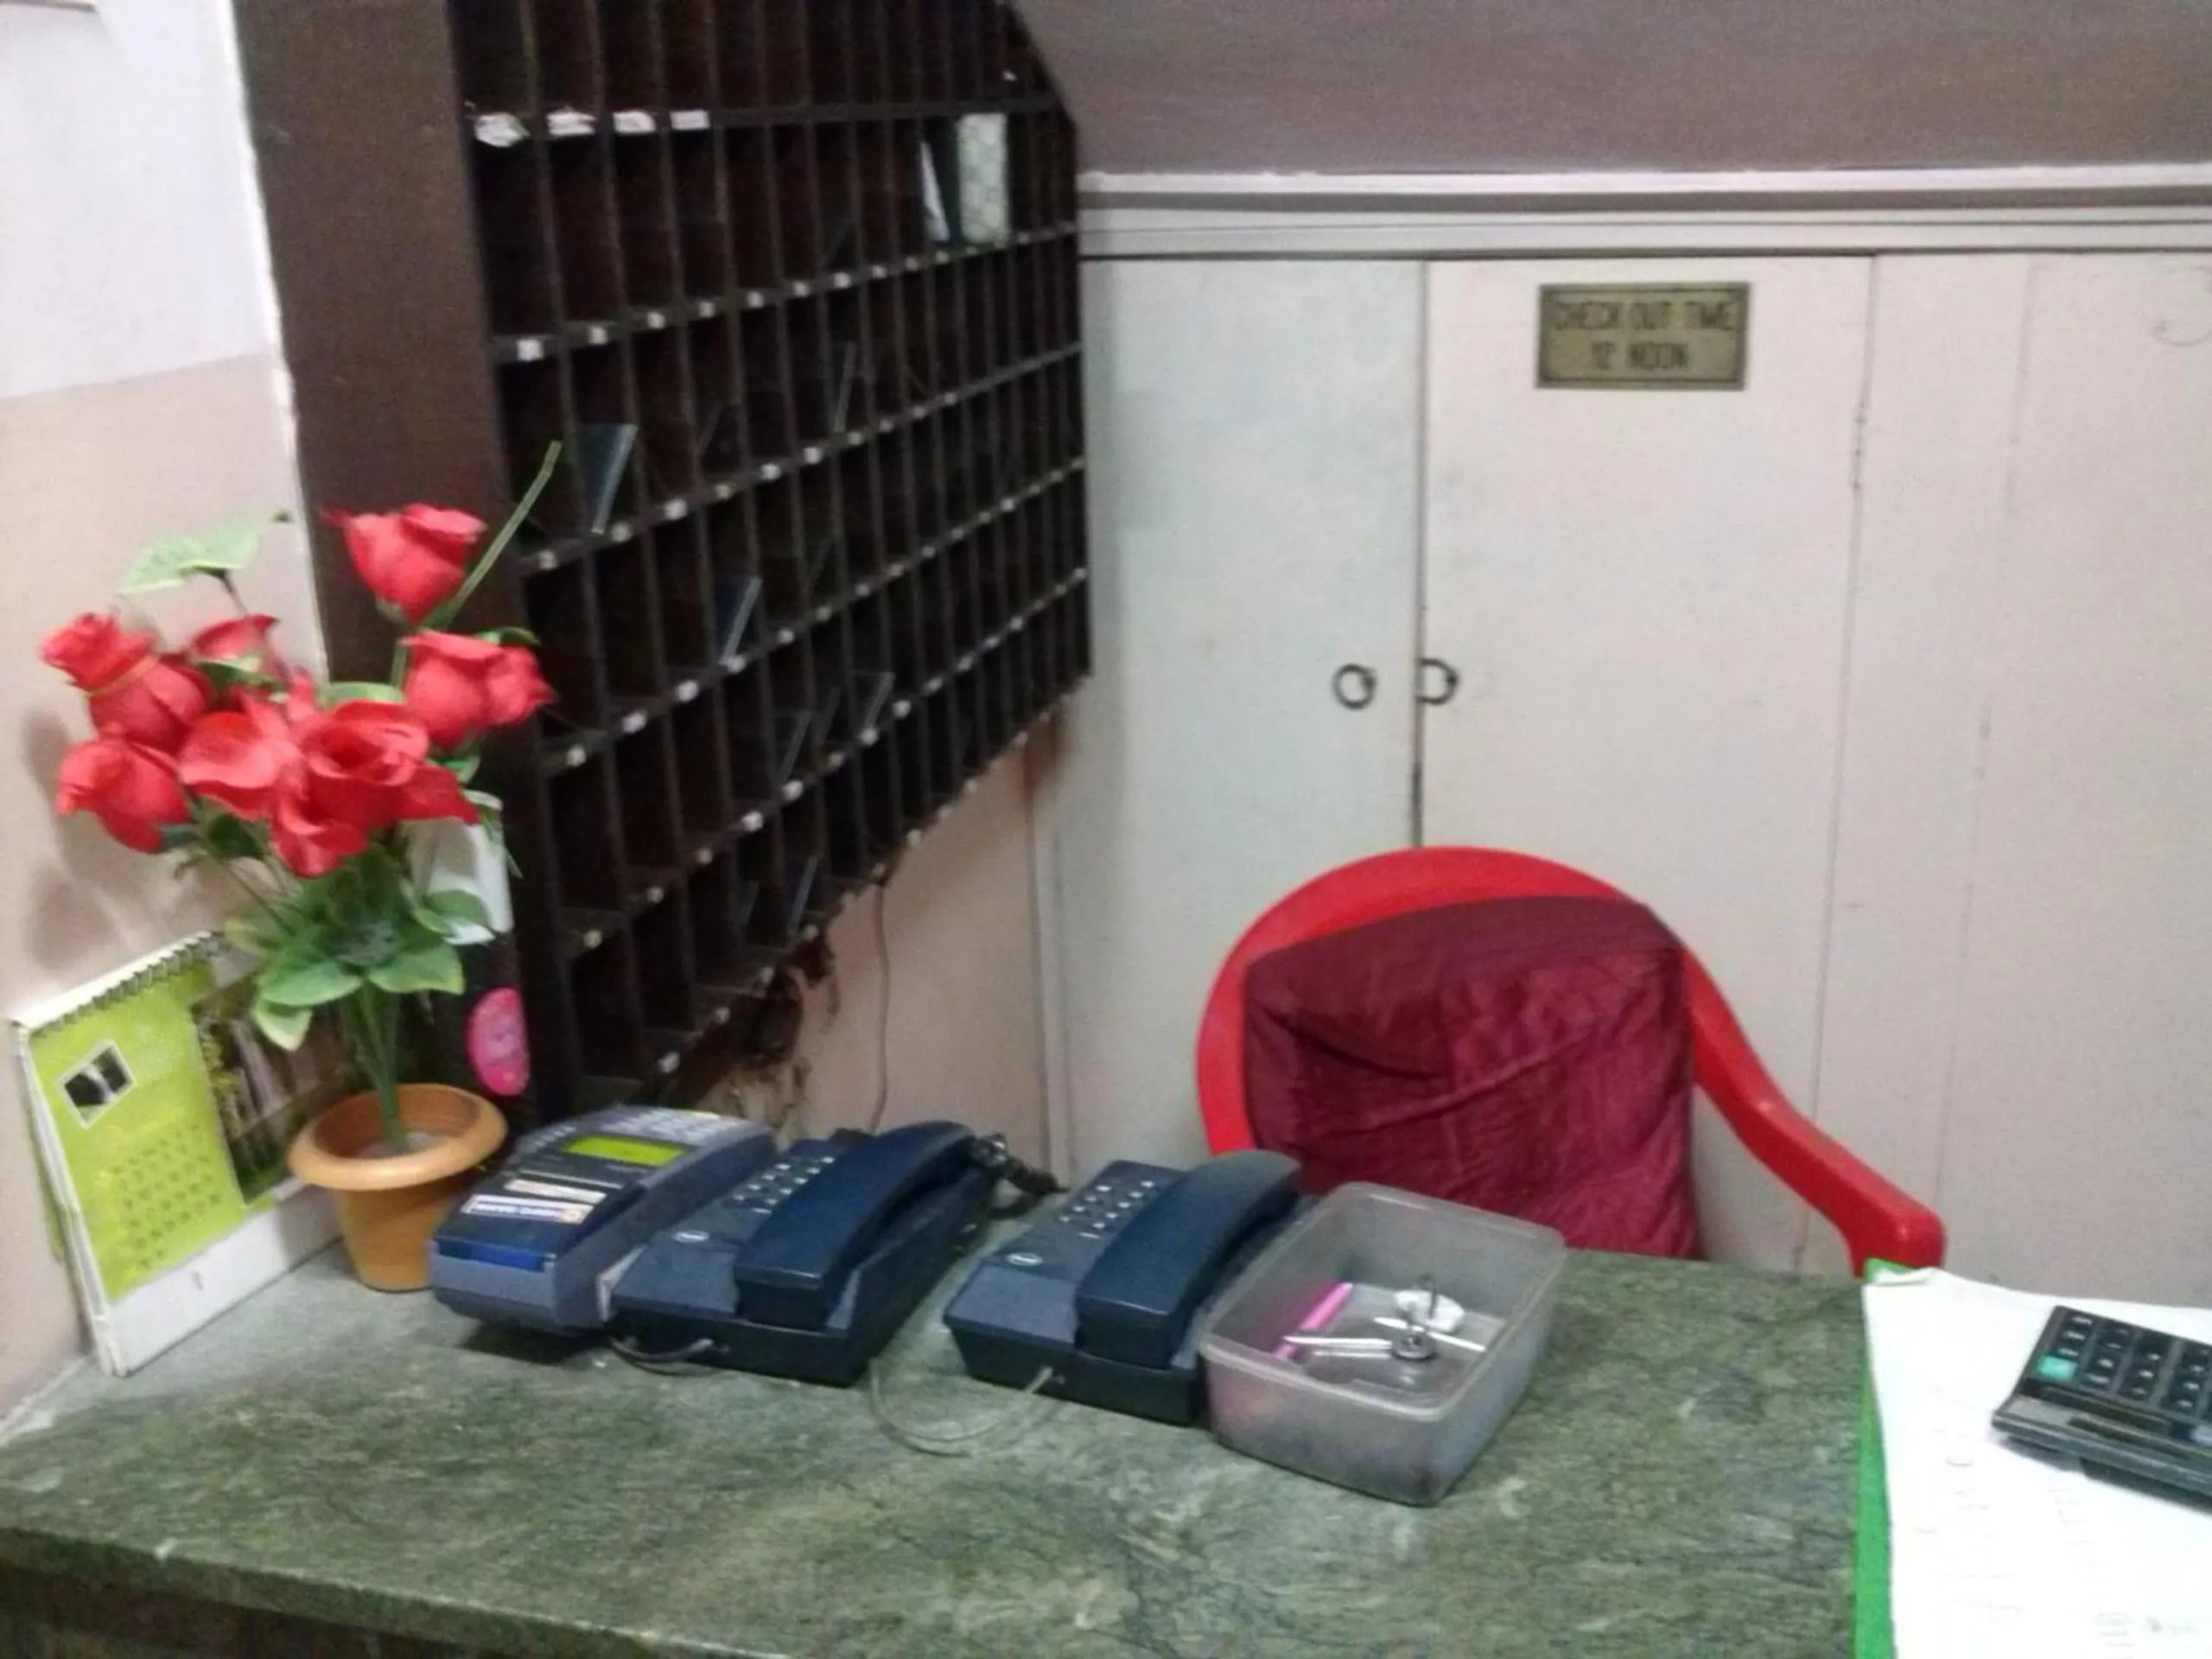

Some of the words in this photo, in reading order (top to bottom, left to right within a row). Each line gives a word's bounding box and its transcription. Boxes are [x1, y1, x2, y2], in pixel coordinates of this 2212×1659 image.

[1629, 301, 1673, 330] OUT
[1684, 300, 1737, 331] TIME
[1629, 342, 1688, 372] NOON
